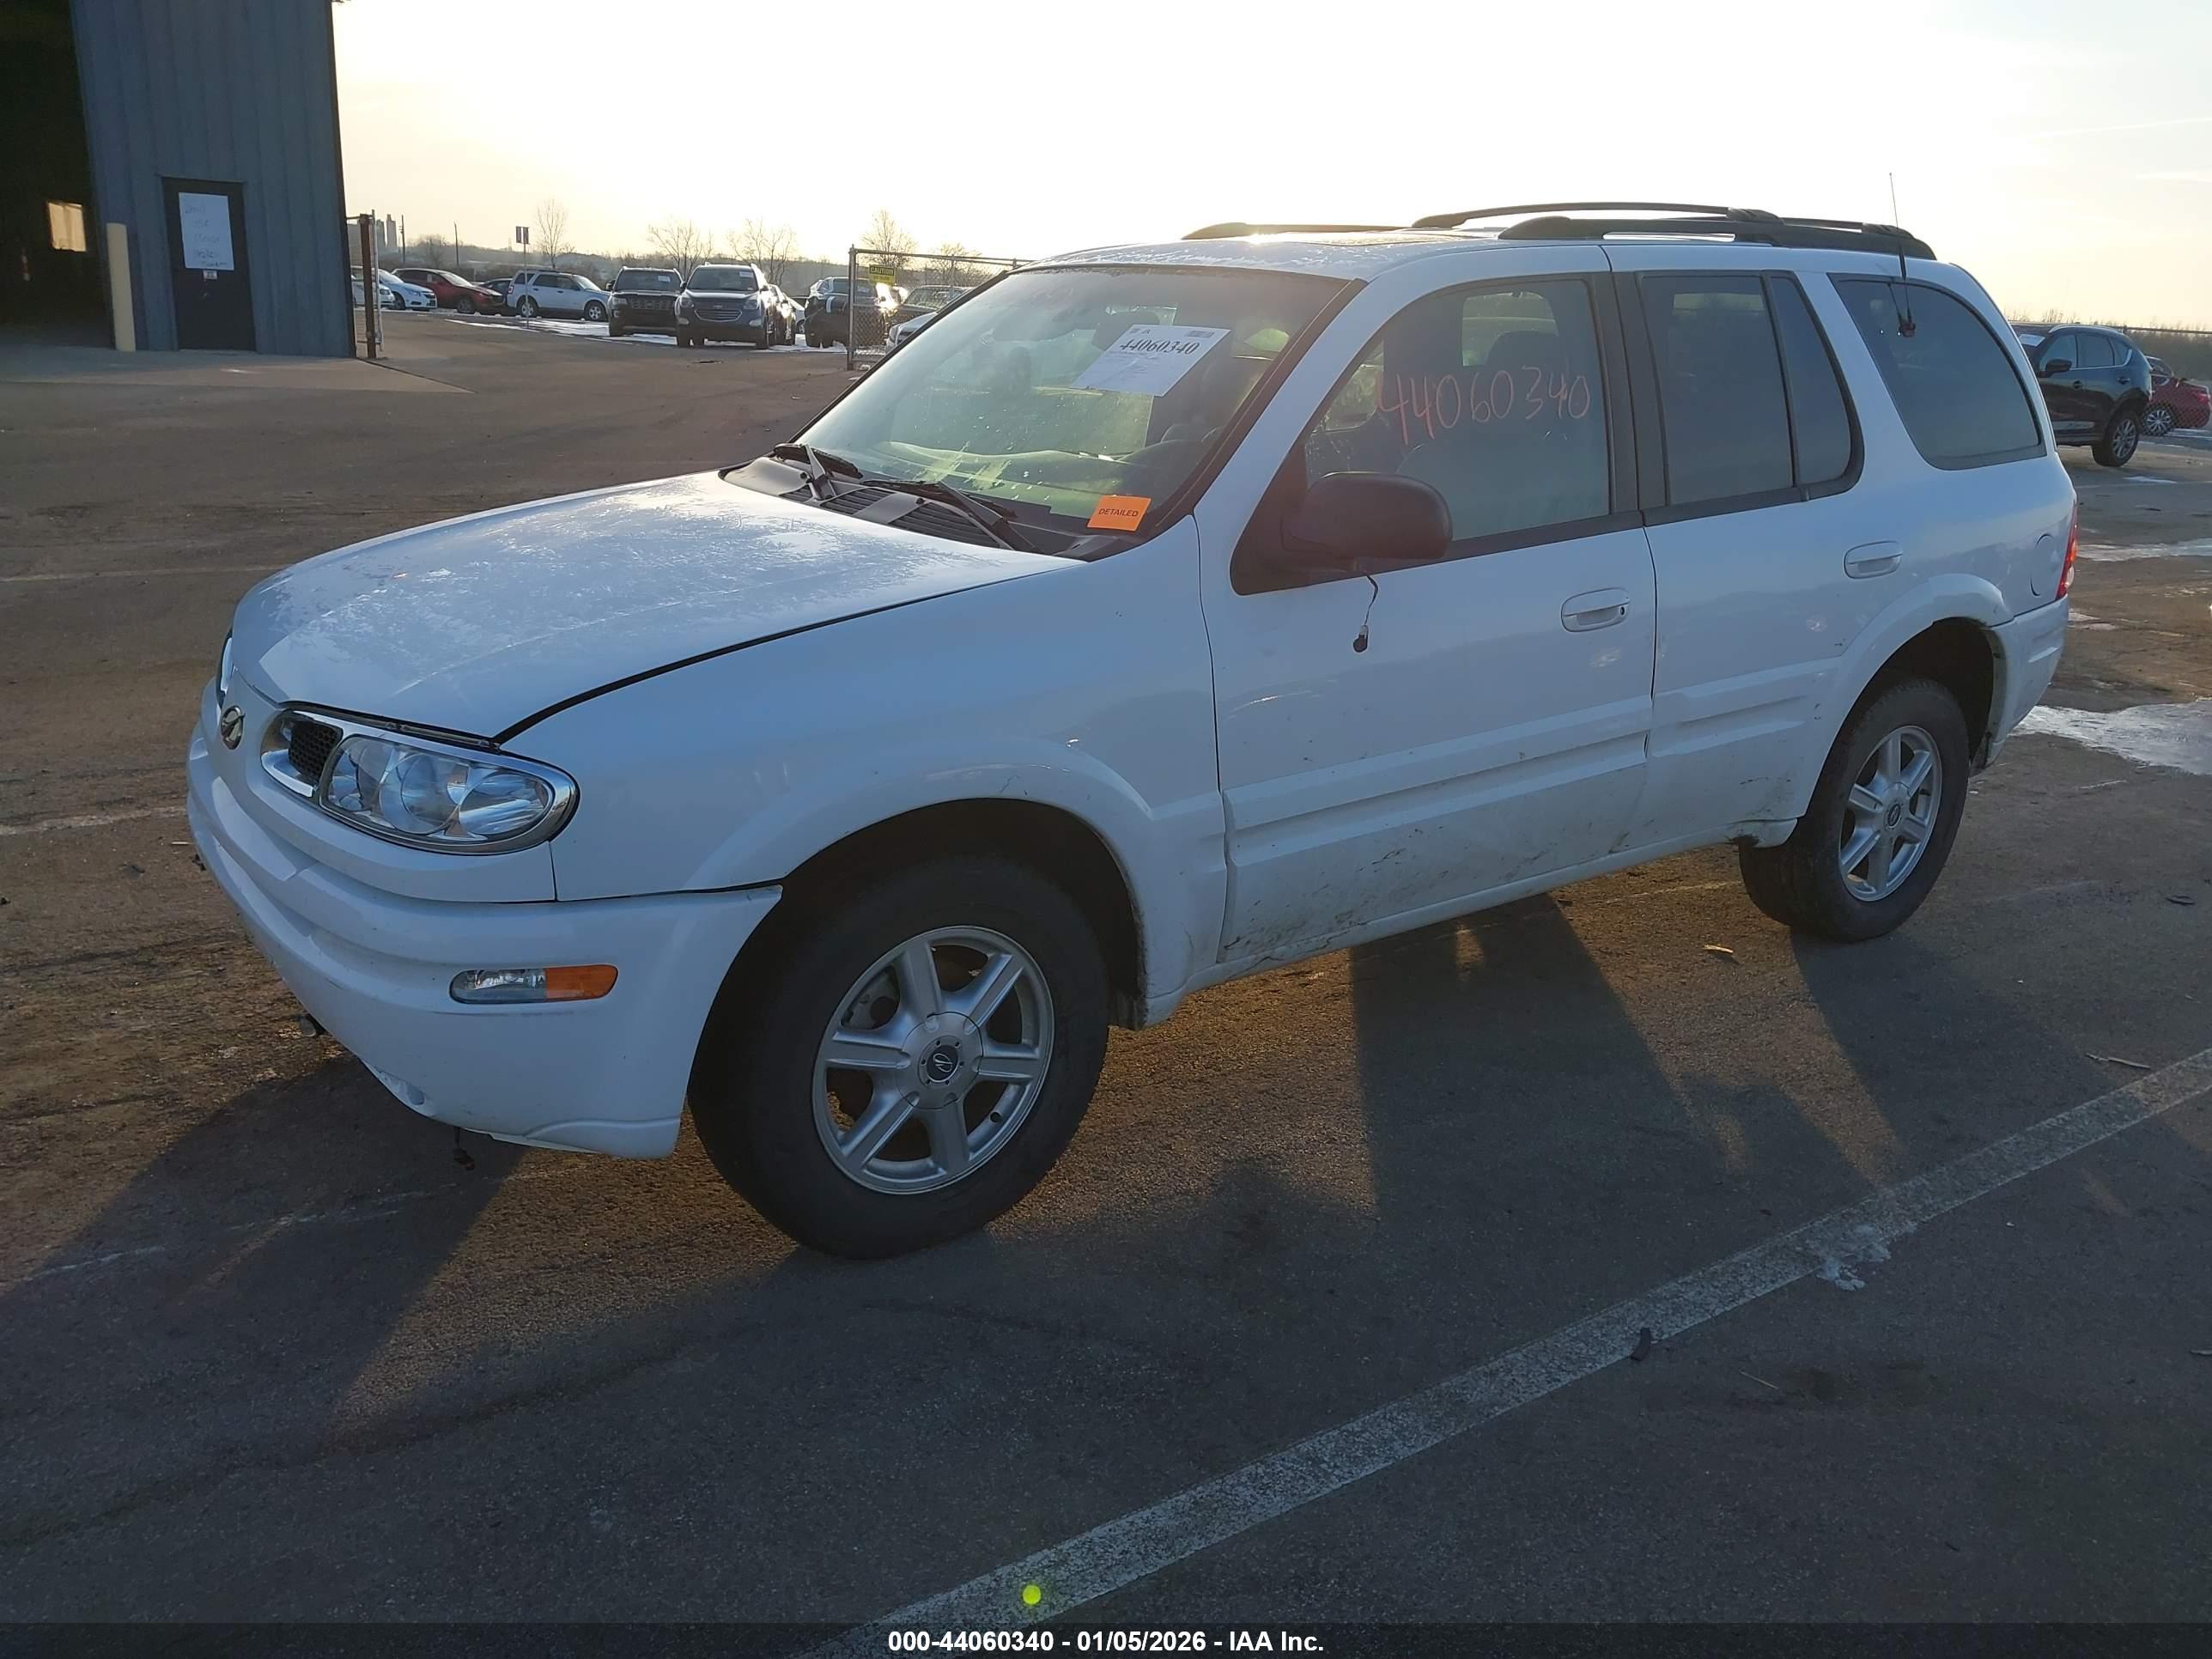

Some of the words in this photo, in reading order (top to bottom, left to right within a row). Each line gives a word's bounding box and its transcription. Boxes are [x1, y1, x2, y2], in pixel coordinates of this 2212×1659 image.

[871, 266, 894, 275] CAUTION
[1120, 339, 1200, 355] 44060340
[1376, 367, 1590, 445] 44060340
[1098, 508, 1138, 517] DETAILED
